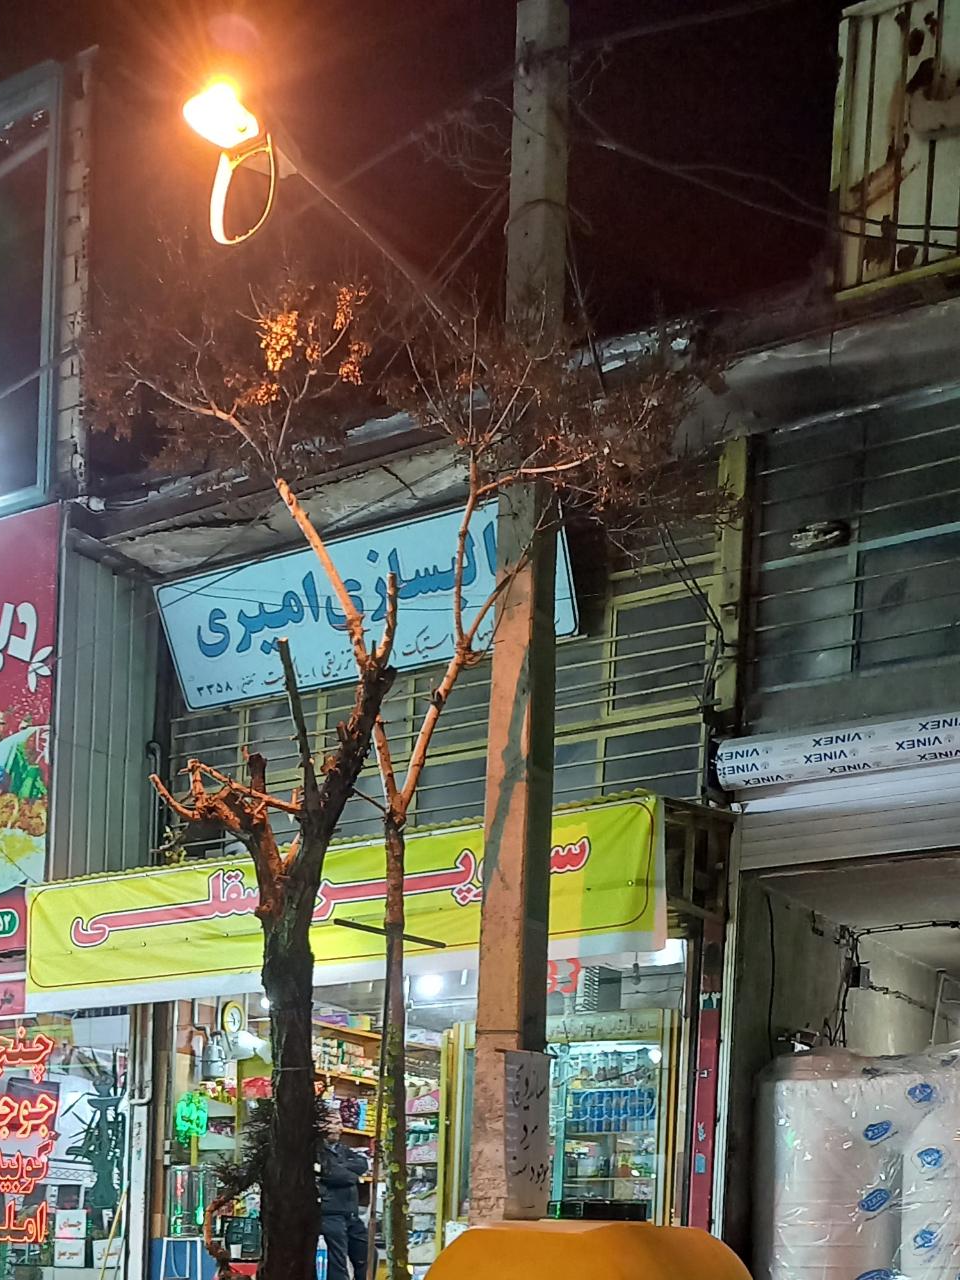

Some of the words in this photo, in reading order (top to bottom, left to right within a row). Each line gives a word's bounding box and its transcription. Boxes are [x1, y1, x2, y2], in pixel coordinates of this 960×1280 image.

[197, 570, 320, 658] امیری
[401, 624, 455, 659] استیک
[811, 731, 863, 749] VINEX
[895, 735, 943, 752] VINEX
[802, 749, 849, 765] VINEX
[826, 762, 873, 775] VINEX
[742, 774, 785, 787] VINEX
[312, 836, 591, 922] سپر
